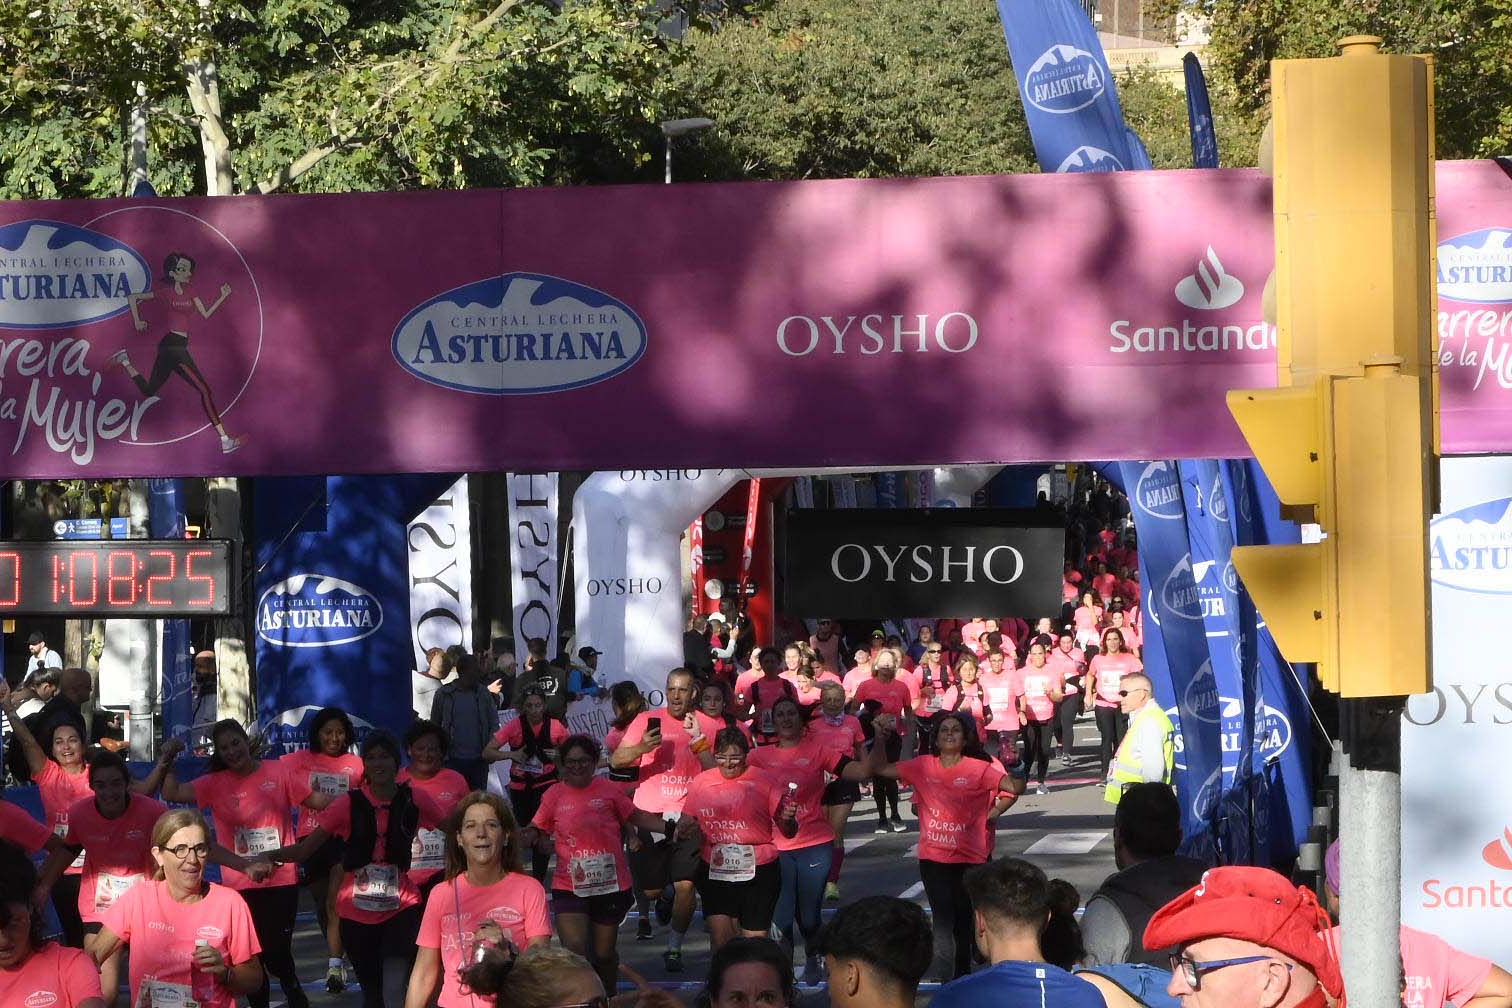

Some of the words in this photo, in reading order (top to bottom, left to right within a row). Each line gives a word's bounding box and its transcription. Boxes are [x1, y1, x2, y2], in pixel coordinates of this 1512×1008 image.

[54, 256, 126, 268] LECHERA
[451, 315, 529, 329] CENTRAL
[537, 313, 617, 327] LECHERA
[412, 318, 628, 366] ASTURIANA
[776, 312, 978, 357] OYSHO
[1460, 342, 1477, 368] la
[12, 366, 161, 465] Mujer
[831, 543, 1024, 584] OYSHO
[587, 577, 662, 597] OYSHO
[261, 603, 373, 631] ASTURIANA
[661, 786, 688, 796] SUMA
[928, 818, 967, 833] DORSAL
[927, 831, 957, 845] SUMA
